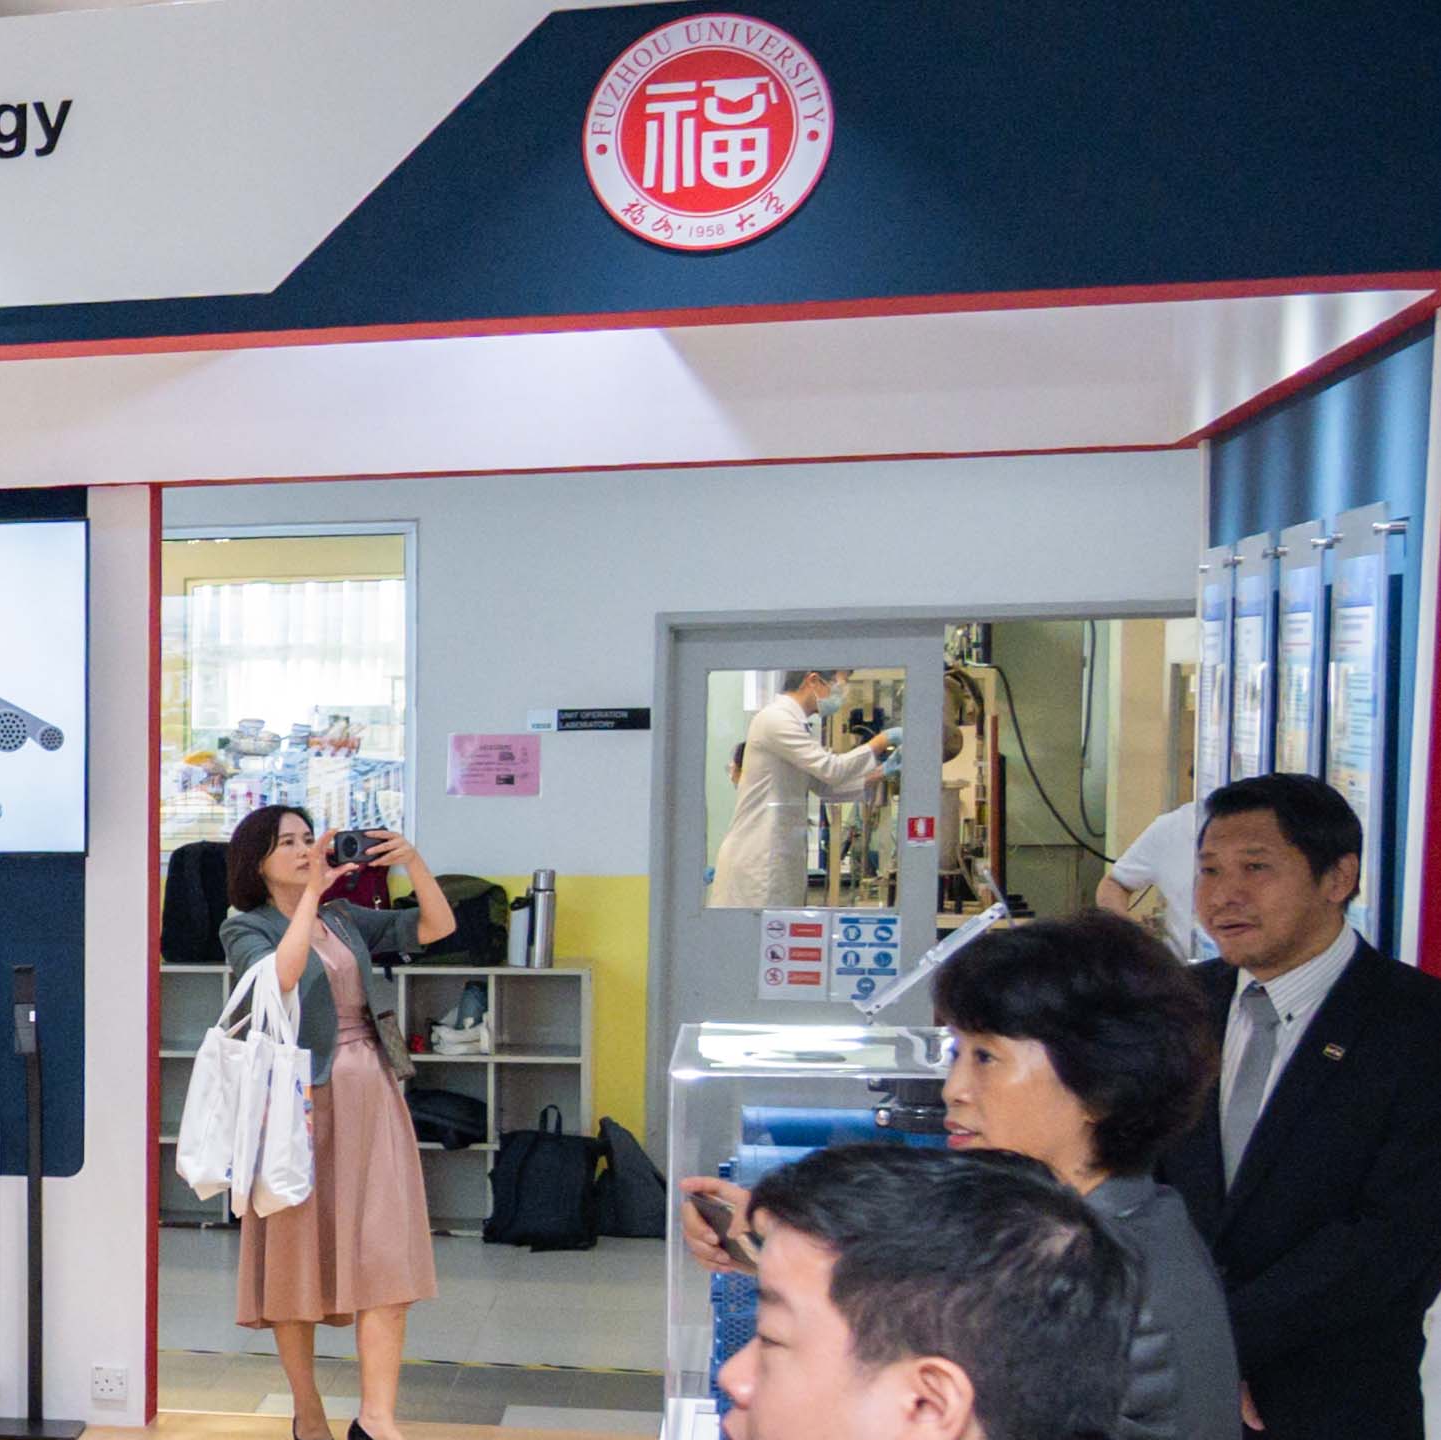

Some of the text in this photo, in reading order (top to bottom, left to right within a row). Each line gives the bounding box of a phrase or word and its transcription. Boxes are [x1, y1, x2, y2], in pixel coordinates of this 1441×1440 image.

[591, 21, 826, 136] FUZHOU UNIVERSITY
[687, 224, 726, 239] 1958
